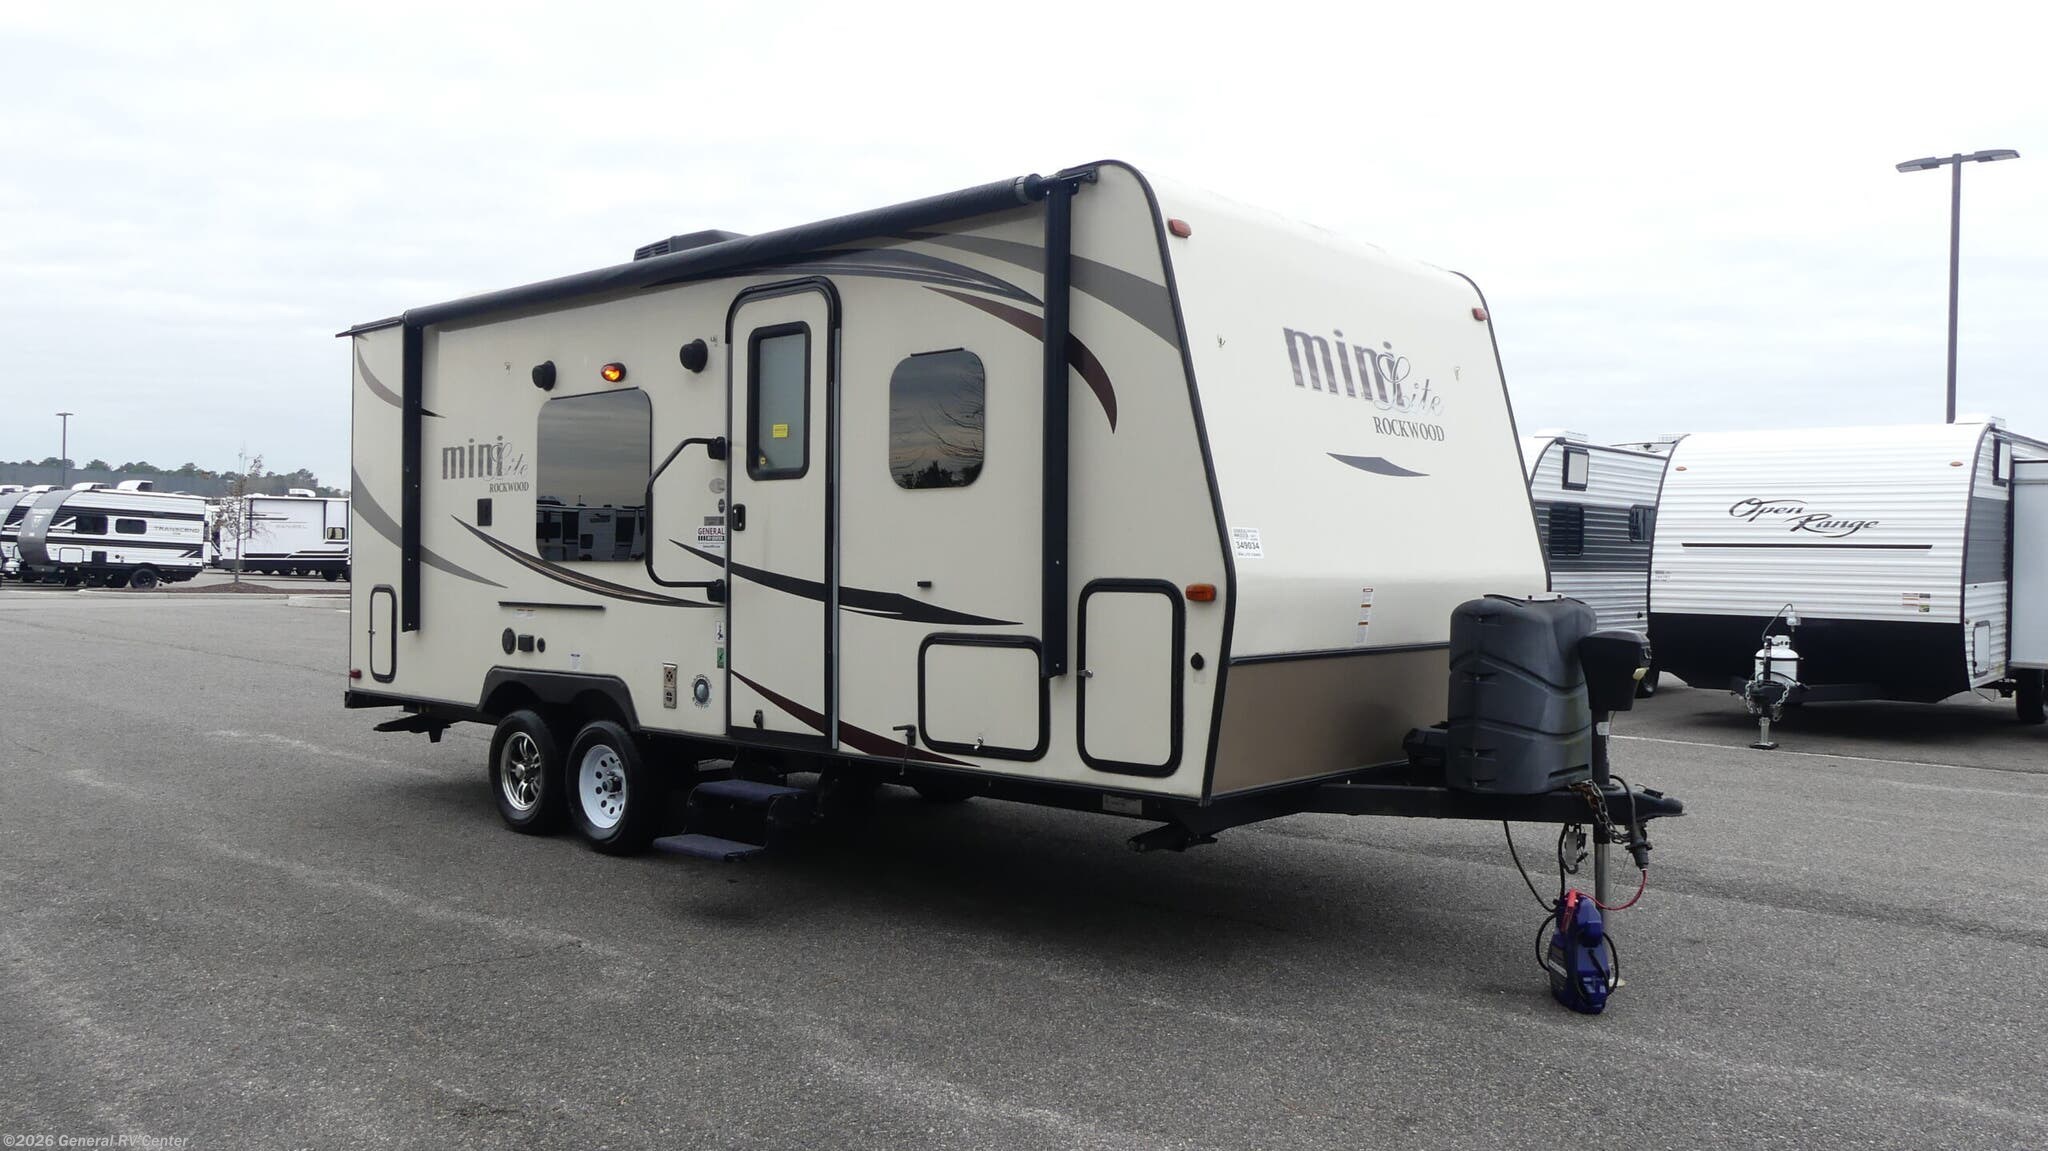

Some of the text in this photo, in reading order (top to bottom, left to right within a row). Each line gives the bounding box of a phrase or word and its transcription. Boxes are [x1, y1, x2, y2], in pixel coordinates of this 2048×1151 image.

[1282, 327, 1405, 407] mini
[1373, 416, 1445, 442] ROCKWOOD
[442, 435, 503, 480] mini
[489, 481, 530, 493] ROCKWOOD
[1729, 497, 1808, 522] Open
[697, 527, 725, 536] GENERAL
[1784, 513, 1880, 538] Range
